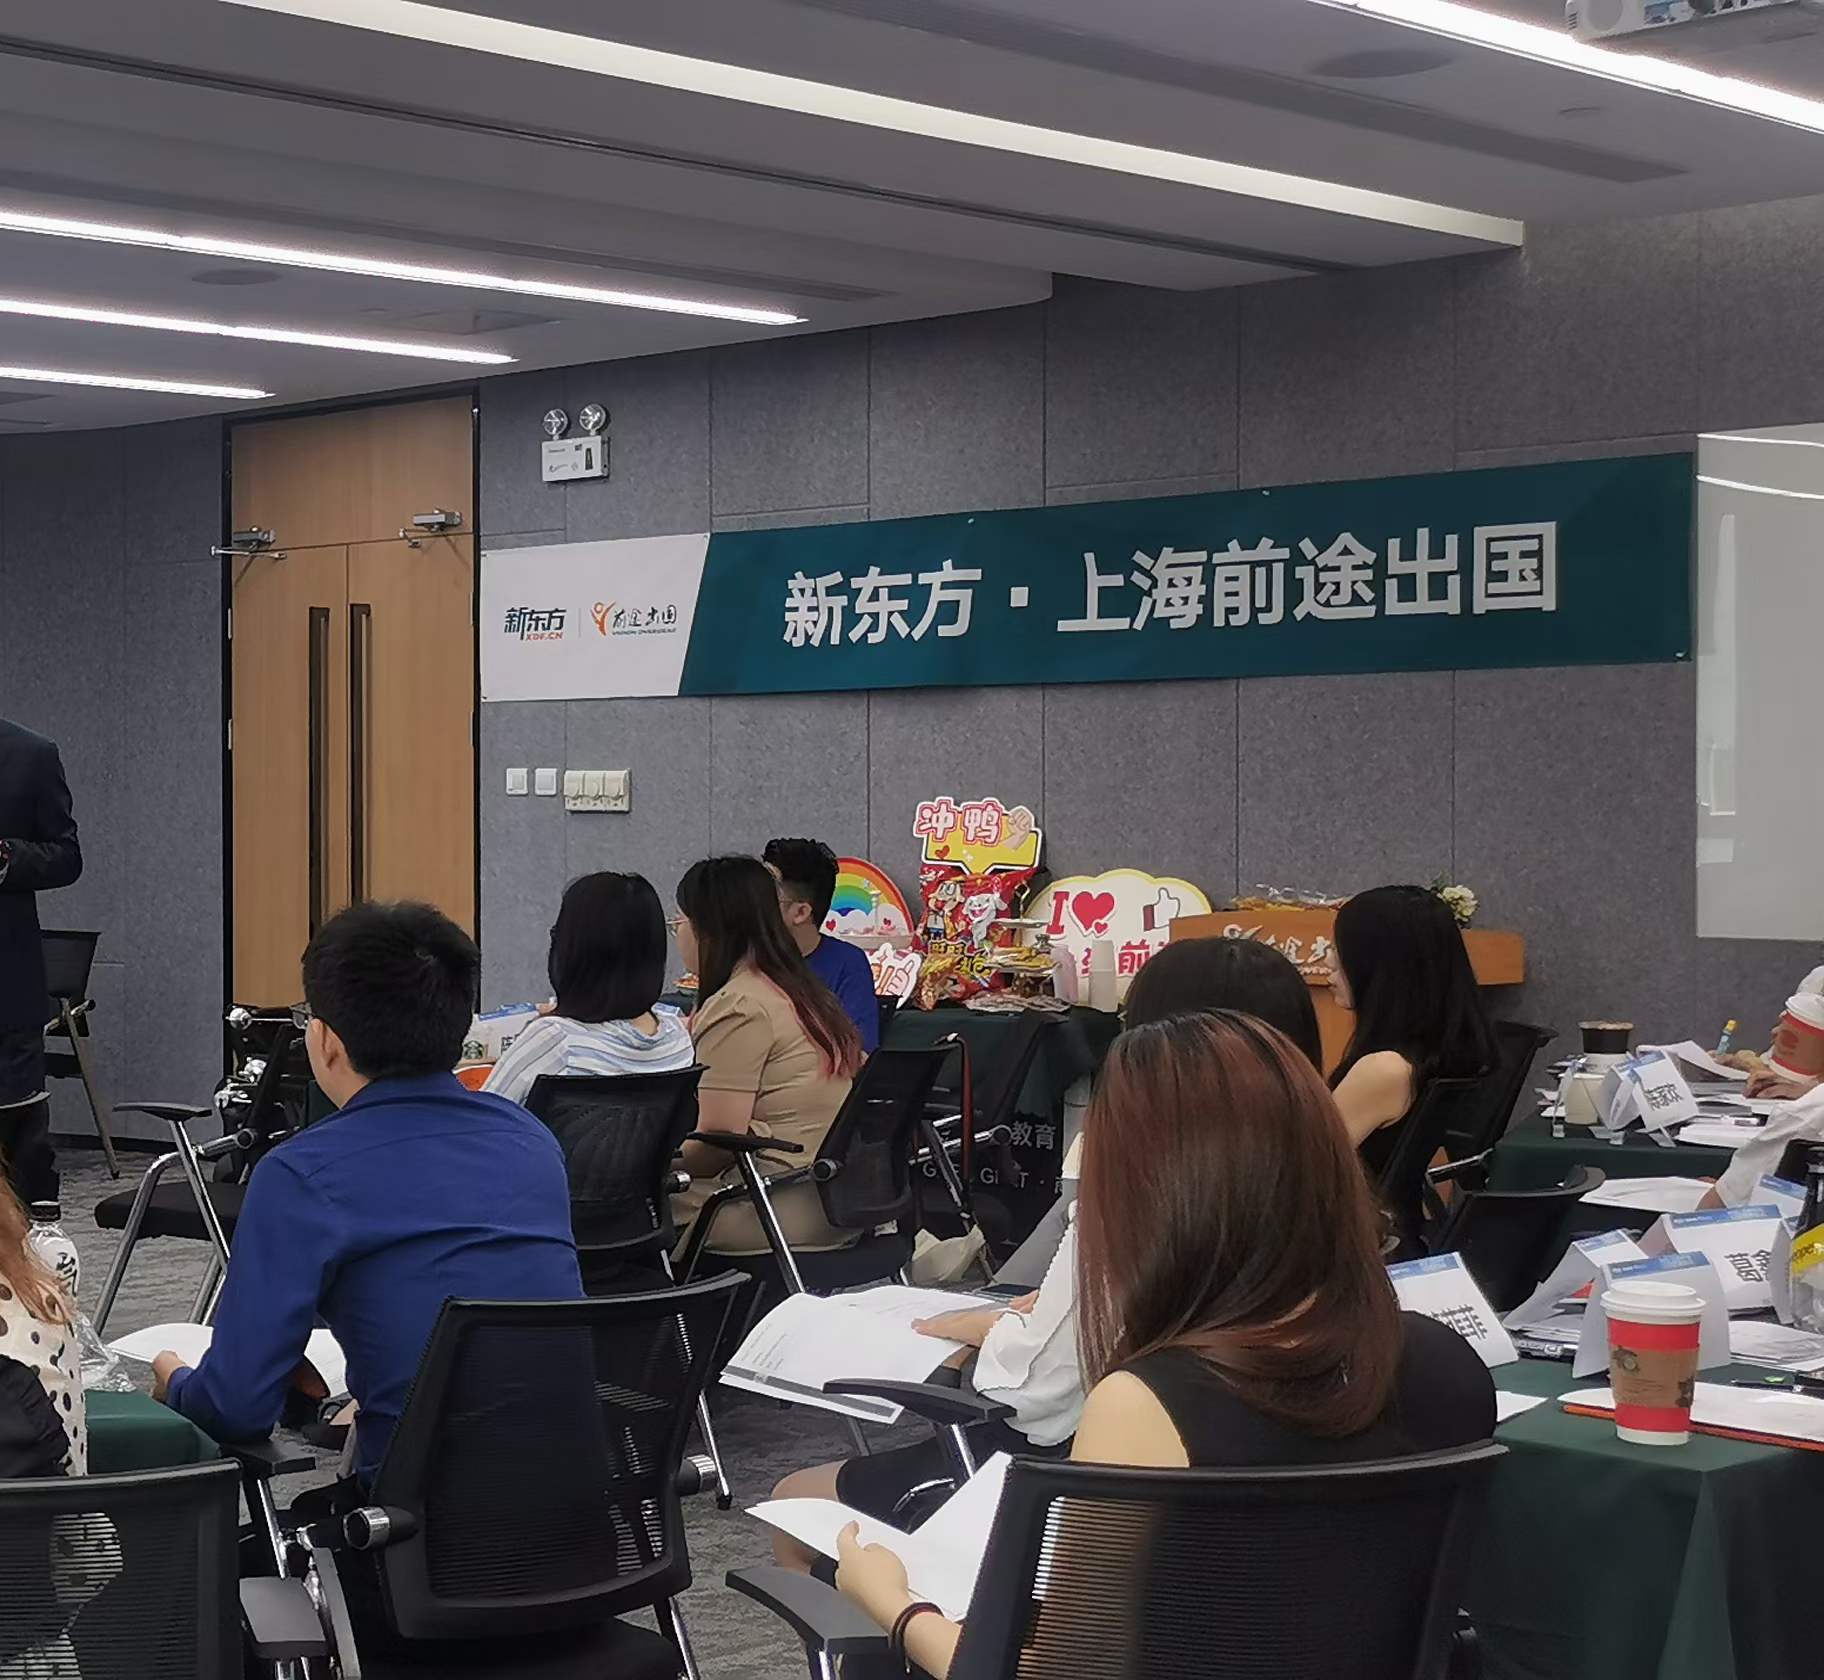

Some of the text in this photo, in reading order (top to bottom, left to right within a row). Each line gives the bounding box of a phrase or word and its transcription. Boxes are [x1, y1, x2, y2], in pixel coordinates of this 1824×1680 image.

[504, 607, 567, 640] 新东方
[526, 631, 564, 641] XDF.CN
[917, 801, 1002, 846] 冲鸭
[1045, 891, 1070, 934] I
[1011, 1121, 1057, 1150] 教育
